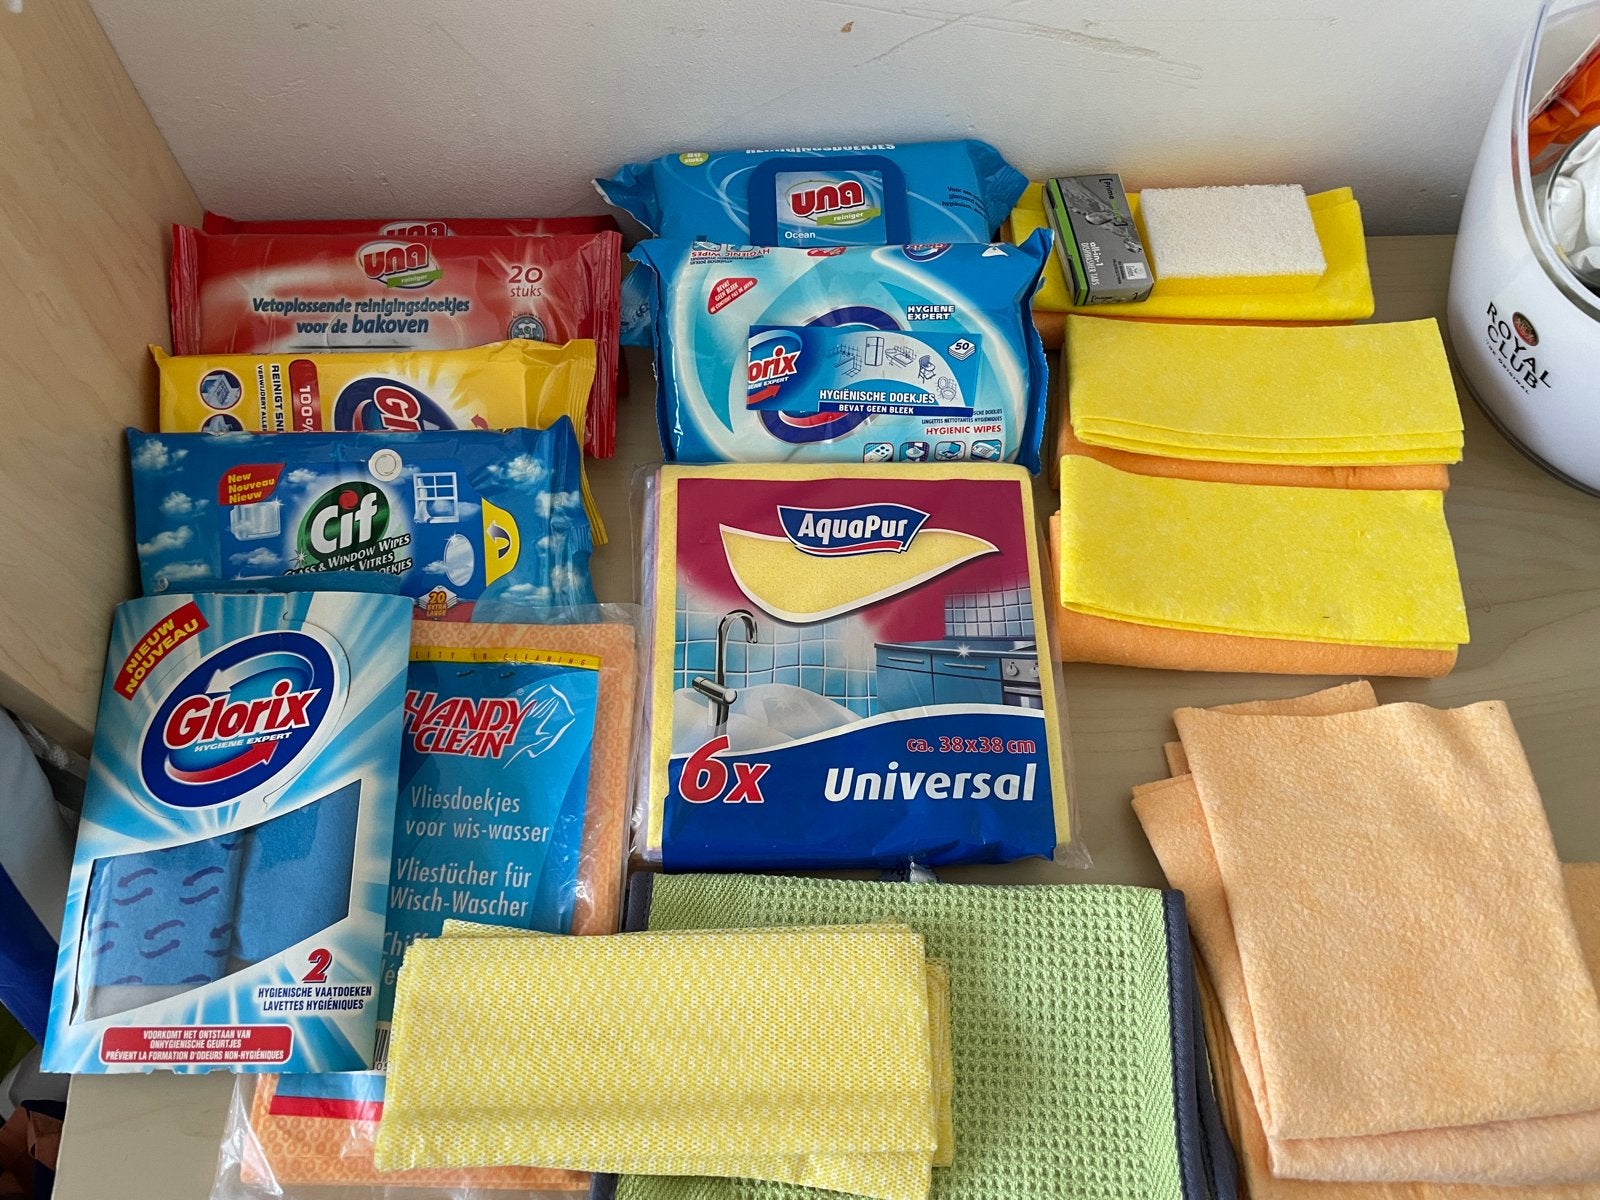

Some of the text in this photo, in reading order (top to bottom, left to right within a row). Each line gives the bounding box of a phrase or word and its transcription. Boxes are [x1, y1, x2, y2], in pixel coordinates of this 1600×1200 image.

[791, 180, 865, 217] una
[833, 212, 864, 222] reiniger
[784, 231, 816, 239] Ocean
[363, 242, 429, 279] una
[508, 265, 544, 284] 20
[510, 284, 542, 298] stuks
[253, 296, 470, 316] Vetoplossende reinigingsdoekjes
[907, 305, 955, 313] HYGIENE
[297, 314, 429, 334] voor de bakoven
[954, 342, 970, 351] 50
[1486, 301, 1552, 389] ROYAL
[748, 345, 801, 383] orix
[1487, 324, 1538, 389] CLUB
[271, 365, 283, 410] REINIGT
[763, 376, 789, 386] EXPERT
[819, 388, 936, 404] HYGIËNISCHE DOEKJES
[839, 404, 914, 414] BEVAT GEEN BLEEK
[926, 425, 1002, 435] HYGIENIC WIPES
[228, 473, 252, 484] New
[228, 478, 275, 494] Nouveau
[229, 491, 263, 504] Nieuw
[311, 489, 378, 554] Cif
[797, 512, 908, 544] AquaPur
[328, 546, 376, 569] WINDOW
[378, 534, 410, 552] WIPES
[428, 591, 447, 604] 20
[125, 618, 175, 674] NIEUW
[125, 618, 199, 693] NOUVEAU
[163, 678, 322, 749] Glorix
[404, 689, 537, 746] HANDY
[194, 731, 293, 752] HYGIENE EXPERT
[413, 725, 508, 759] CLEAN
[906, 738, 934, 752] ca.
[1007, 739, 1037, 754] cm
[678, 735, 771, 804] 6x
[824, 760, 1038, 802] Universal
[411, 784, 521, 816] Vliesdoekjes
[405, 817, 550, 842] voor wis-wasser
[397, 856, 532, 888] Vliestücher für
[390, 885, 529, 917] Wisch-Wascher
[301, 948, 333, 984] 2
[258, 985, 372, 998] HYGIENISCHE VAATDOEKEN
[263, 997, 364, 1011] LAVETTES HYGIÉNIQUES
[143, 1029, 252, 1040] VOORKOMT HET ONTSTAAN VAN
[150, 1039, 242, 1049] ONHYGIENISCHE GEURTJES
[105, 1048, 284, 1061] PRÉVIENT LA FORMATION D'ODEURS NON-HYGIÉNIQUES
